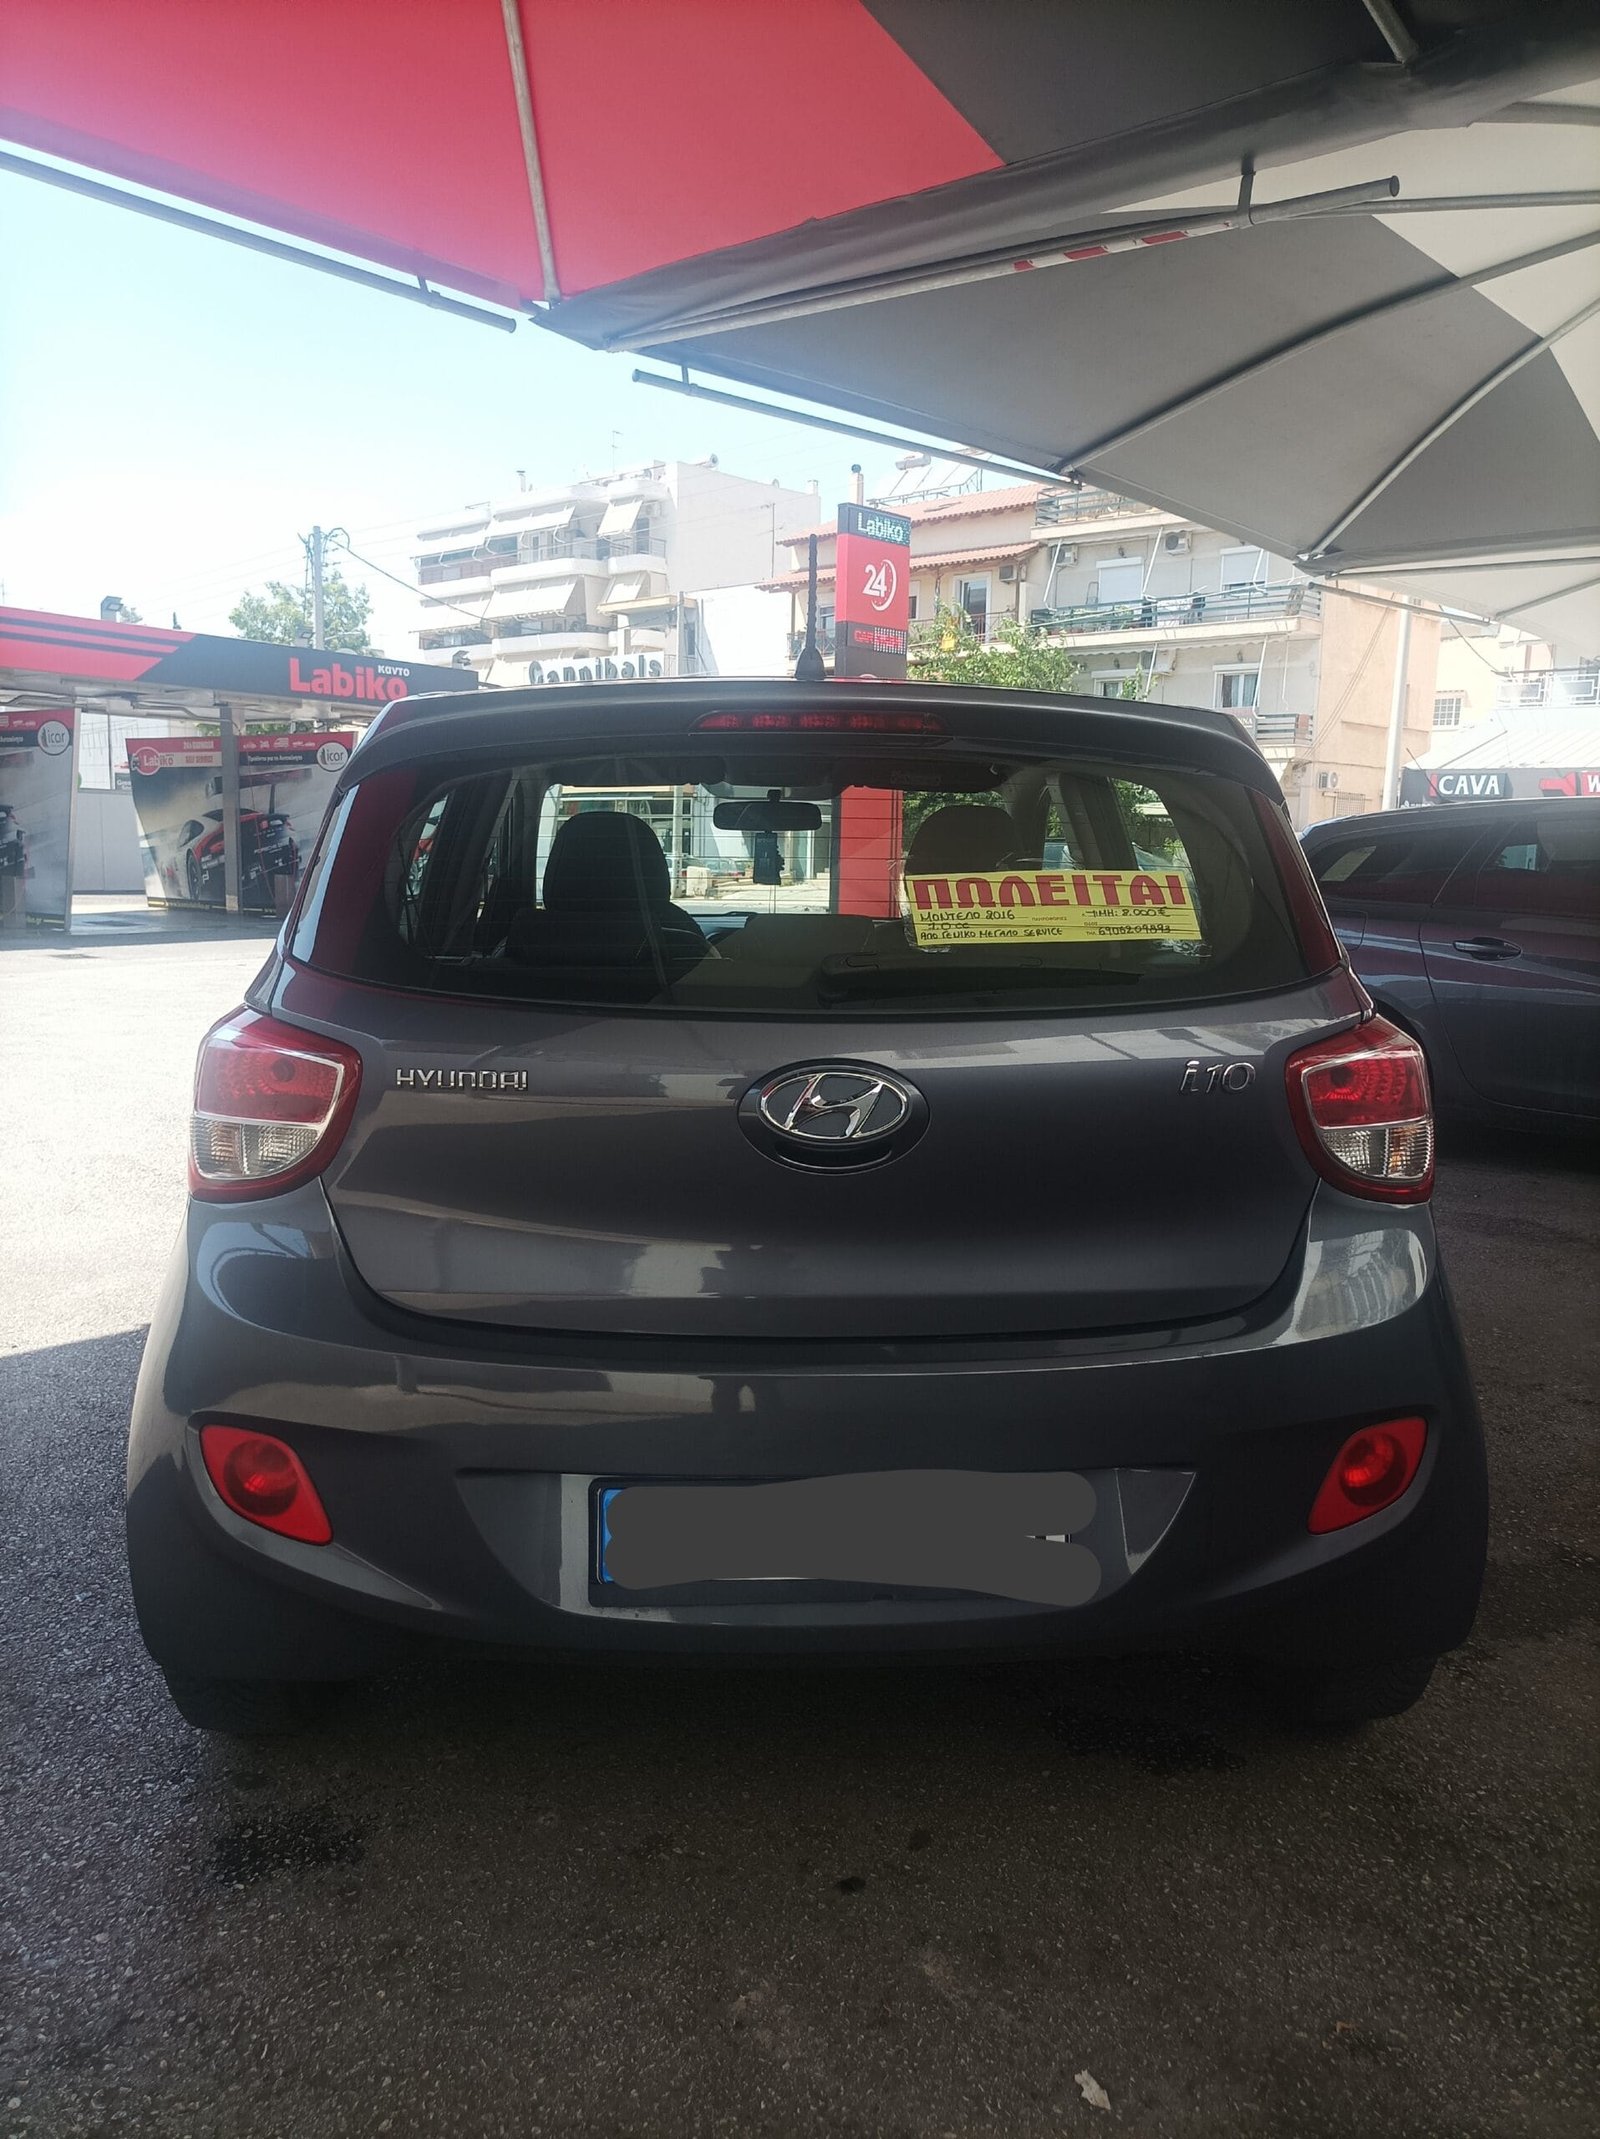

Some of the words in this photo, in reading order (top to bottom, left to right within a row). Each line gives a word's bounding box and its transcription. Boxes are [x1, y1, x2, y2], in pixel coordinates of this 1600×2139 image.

[857, 512, 903, 542] Labiko
[862, 563, 887, 598] 24
[290, 657, 408, 700] Labiko
[1438, 774, 1500, 795] CAVA
[912, 874, 1187, 910] ΠΩΛΕΙΤΑΙ
[985, 909, 1016, 920] 2016
[396, 1069, 528, 1090] HYUNDAI
[1180, 1060, 1256, 1093] i10
